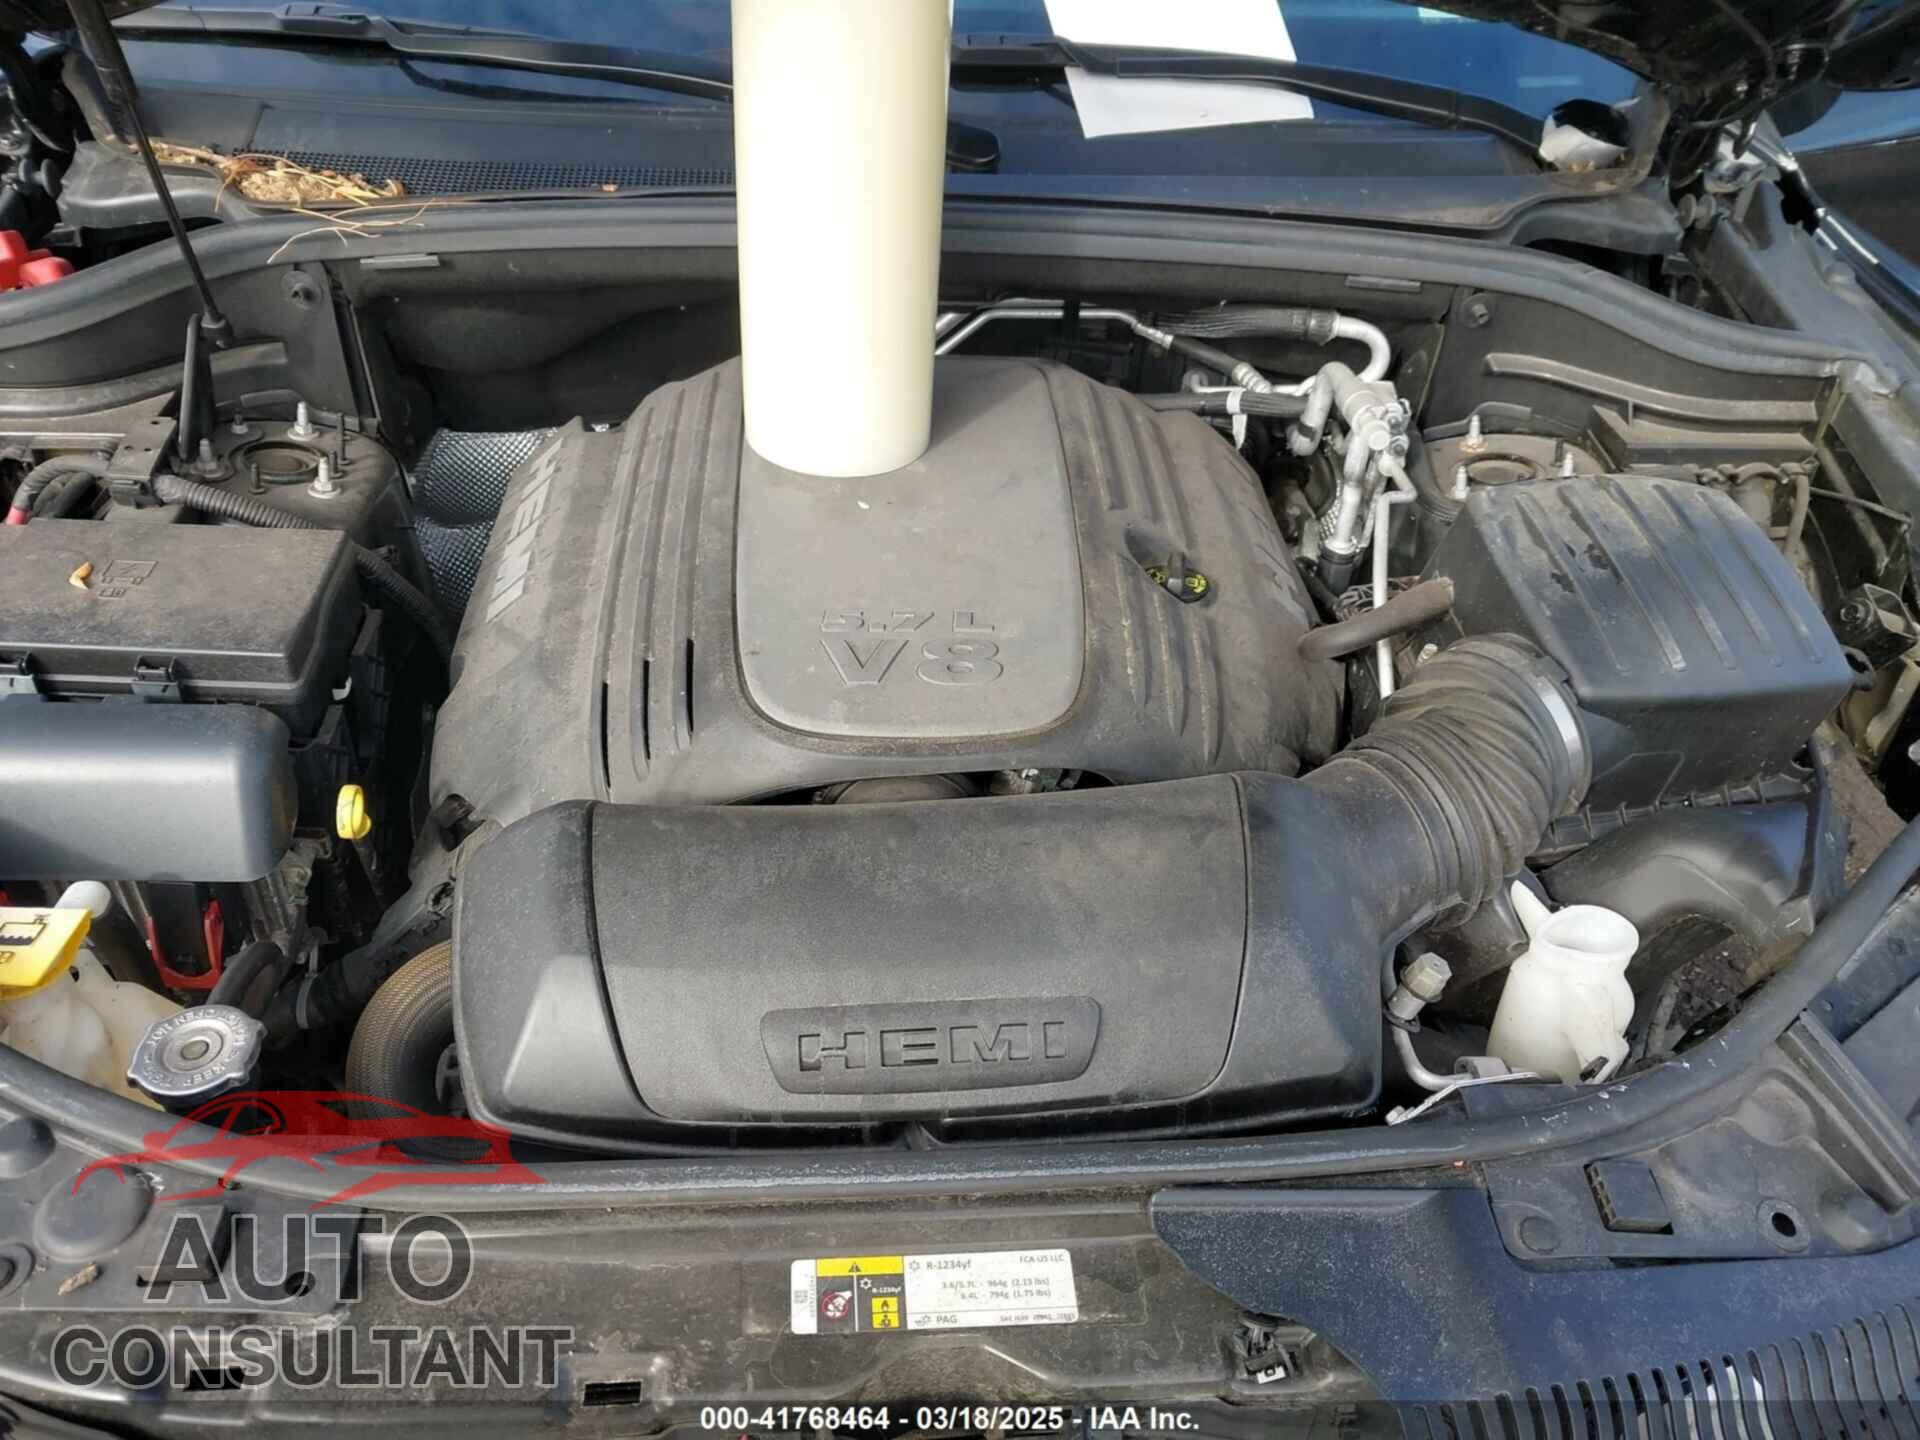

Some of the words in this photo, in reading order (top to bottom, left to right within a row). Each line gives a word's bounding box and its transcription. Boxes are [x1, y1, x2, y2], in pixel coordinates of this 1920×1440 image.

[819, 638, 1004, 687] V8
[798, 1020, 1067, 1072] HEMI
[926, 1259, 972, 1272] R-1234yf
[936, 1315, 958, 1324] PAG
